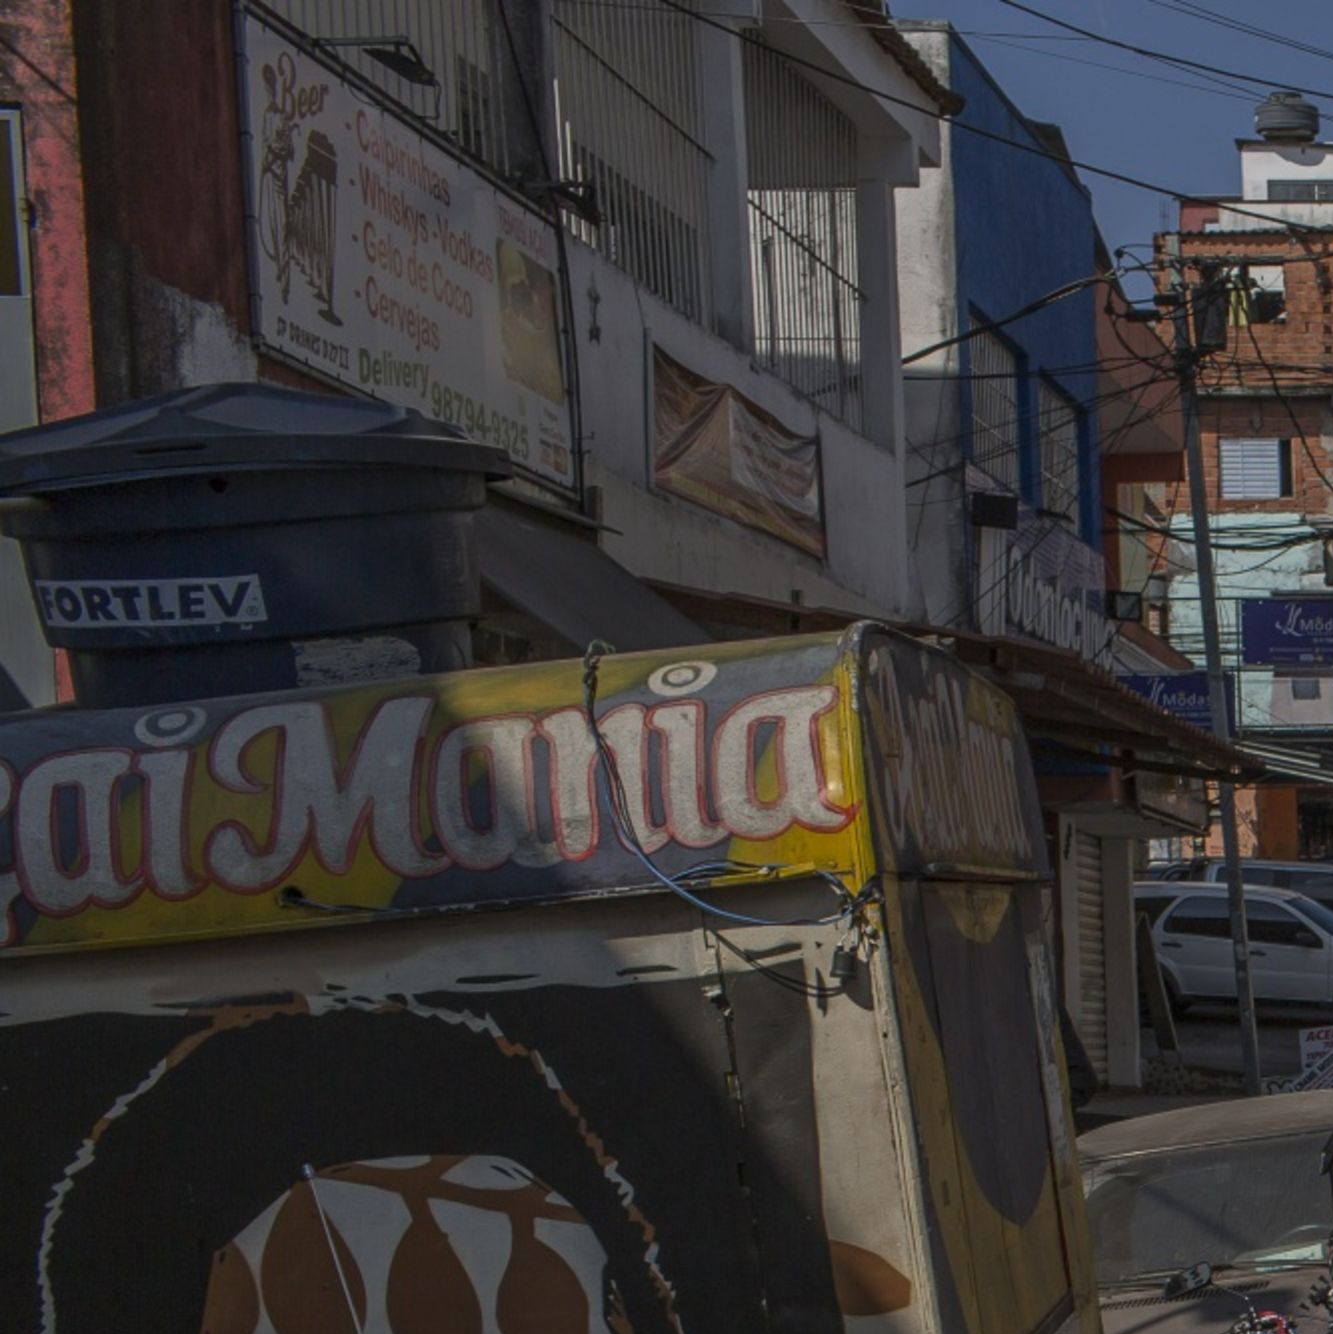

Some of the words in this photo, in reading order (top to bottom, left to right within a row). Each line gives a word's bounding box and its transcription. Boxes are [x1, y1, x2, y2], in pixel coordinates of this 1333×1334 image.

[278, 52, 329, 120] Beer
[357, 109, 450, 207] Caipirinhas
[359, 162, 429, 247] Whiskys
[363, 221, 403, 279] Gelo
[407, 248, 428, 294] de
[432, 261, 475, 318] Coco
[366, 275, 441, 353] Cervejas
[358, 347, 429, 398] Delivery
[39, 581, 252, 623] FORTLEV
[0, 690, 862, 947] aiMania
